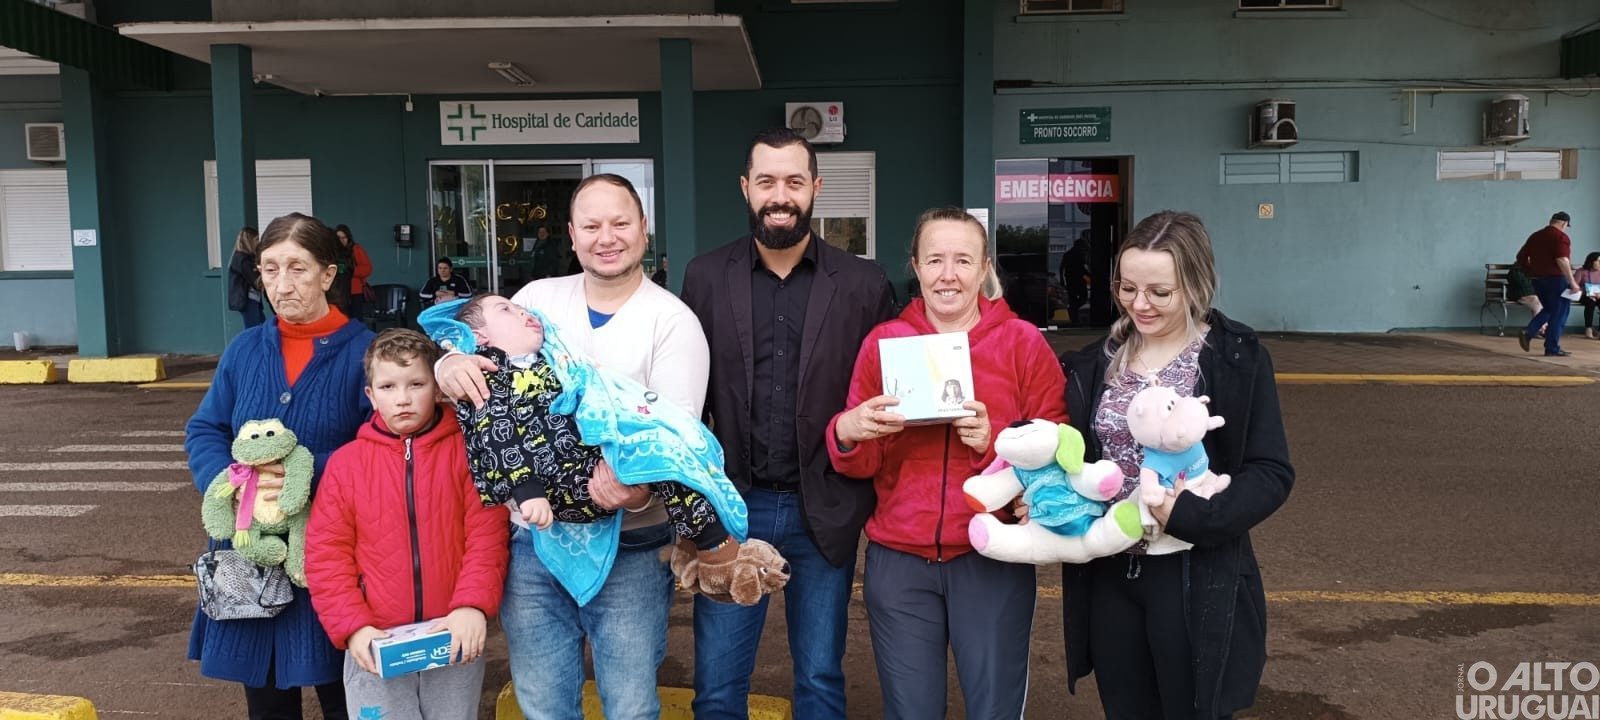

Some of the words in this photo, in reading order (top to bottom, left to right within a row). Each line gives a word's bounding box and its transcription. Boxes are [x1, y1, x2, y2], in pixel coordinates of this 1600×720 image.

[492, 112, 549, 132] Hospital
[553, 113, 571, 128] de
[575, 111, 638, 128] Caridade
[1033, 126, 1062, 138] PRONTO
[1063, 125, 1098, 137] SOCORRO
[1000, 176, 1113, 198] EMERGÊNCIA
